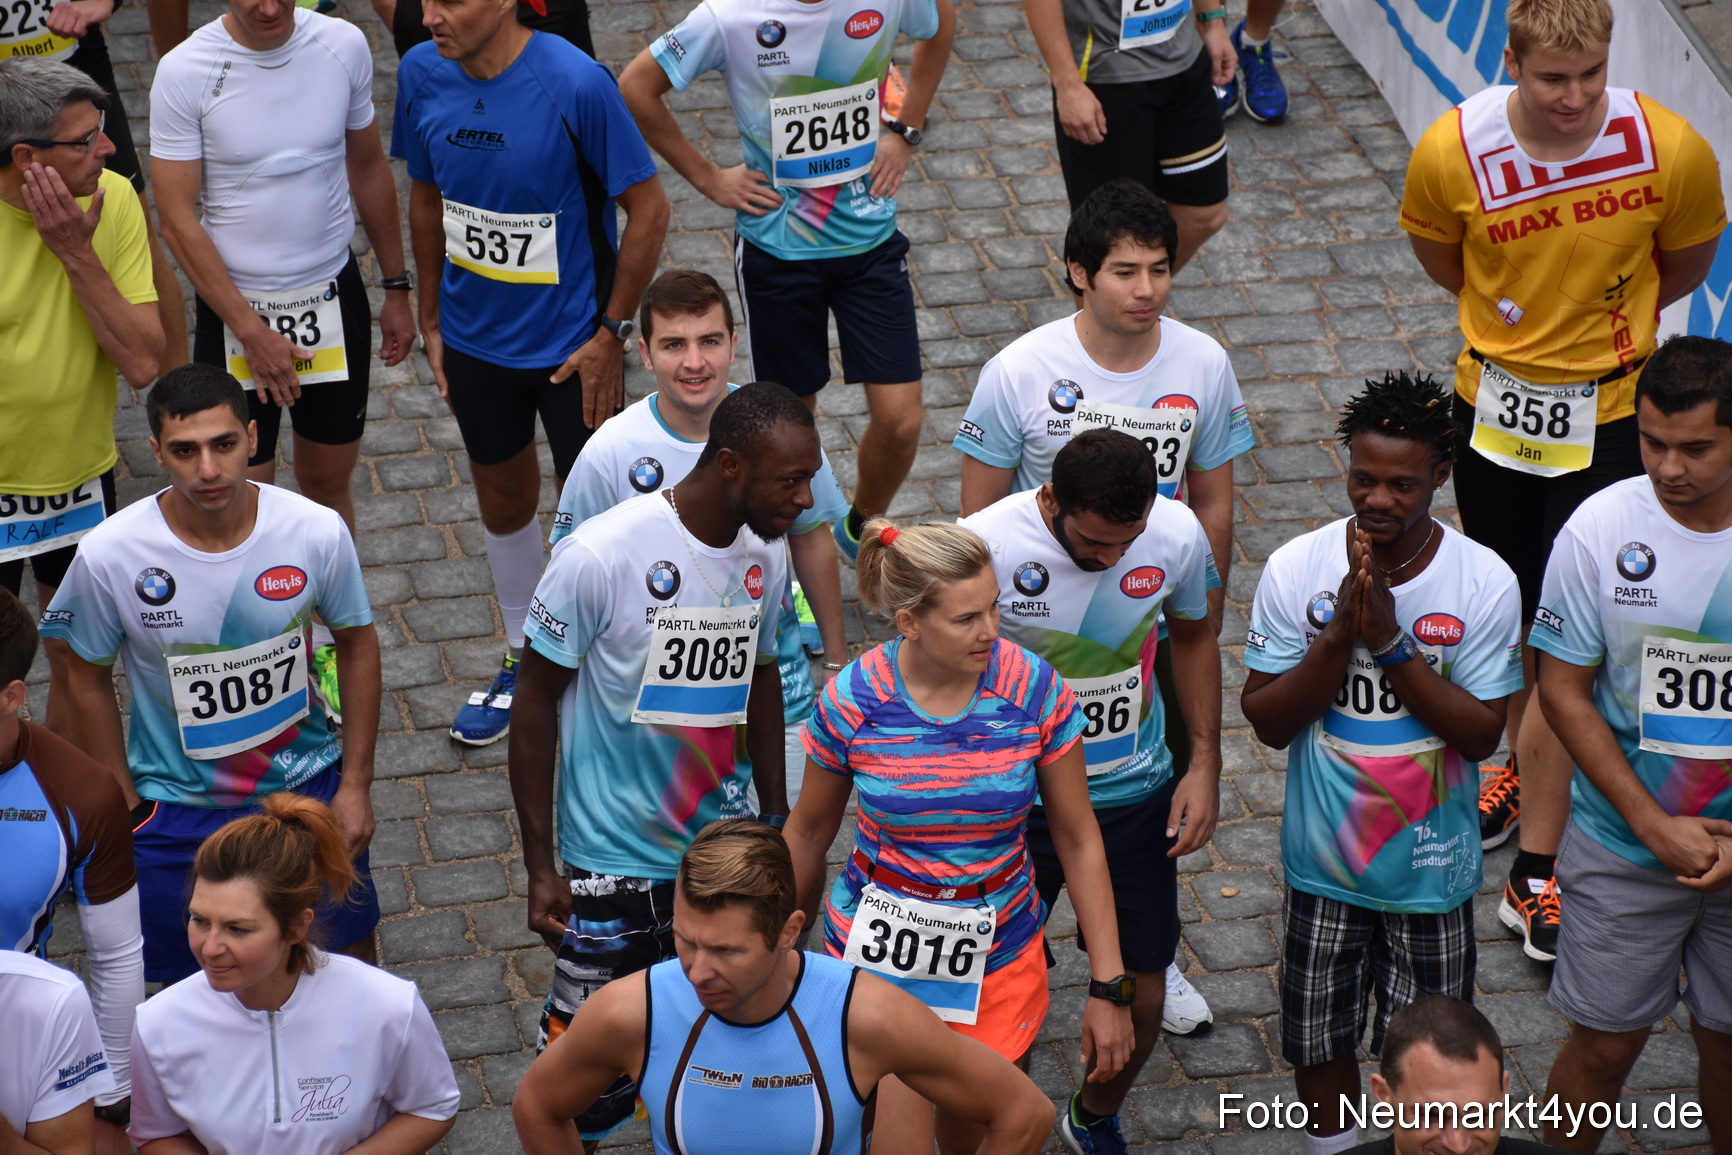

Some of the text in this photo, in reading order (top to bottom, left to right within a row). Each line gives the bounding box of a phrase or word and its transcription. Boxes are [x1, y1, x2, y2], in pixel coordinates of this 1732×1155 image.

[850, 16, 879, 32] Hervis
[12, 38, 54, 56] Albert
[757, 51, 789, 61] PARTL
[758, 59, 790, 68] Neumarkt
[774, 95, 862, 117] PARTL Neumarkt
[455, 129, 505, 144] ERTEL
[785, 106, 870, 155] 2648
[808, 157, 851, 175] Niklas
[445, 203, 534, 228] PARTL Neumarkt
[1487, 185, 1664, 245] MAX BÖGL
[465, 224, 532, 267] 537
[267, 295, 320, 311] Neumarkt
[1047, 419, 1073, 429] PAR
[1077, 411, 1176, 431] PARTL Neumarkt
[1498, 391, 1571, 439] 358
[1047, 429, 1071, 437] Neum
[1516, 443, 1542, 461] Jan
[7, 515, 65, 544] RALF
[262, 574, 302, 592] Hervis
[1127, 575, 1161, 590] Hervis
[1615, 587, 1657, 599] PARTL
[1012, 601, 1050, 611] PARTL
[1615, 598, 1657, 607] Neumarkt
[140, 610, 182, 622] PARTL
[1012, 609, 1050, 618] Neumarkt
[143, 621, 184, 629] Neumarkt
[657, 619, 696, 631] PARTL
[699, 619, 746, 631] Neumarkt
[1421, 621, 1461, 639] Hervis
[173, 646, 285, 677] PARTL Neumarkt
[659, 636, 750, 681] 3085
[1647, 647, 1694, 663] PARTL
[189, 655, 296, 719] 3087
[274, 749, 298, 769] 16.
[285, 756, 326, 791] Stadtlauf
[1414, 821, 1438, 844] 16.
[1413, 835, 1459, 856] Neumarkter
[1412, 851, 1454, 870] Stadtlauf
[901, 885, 933, 899] new balance
[864, 896, 971, 932] PARTL Neumarkt
[861, 919, 977, 977] 3016
[291, 1074, 351, 1123] Julia
